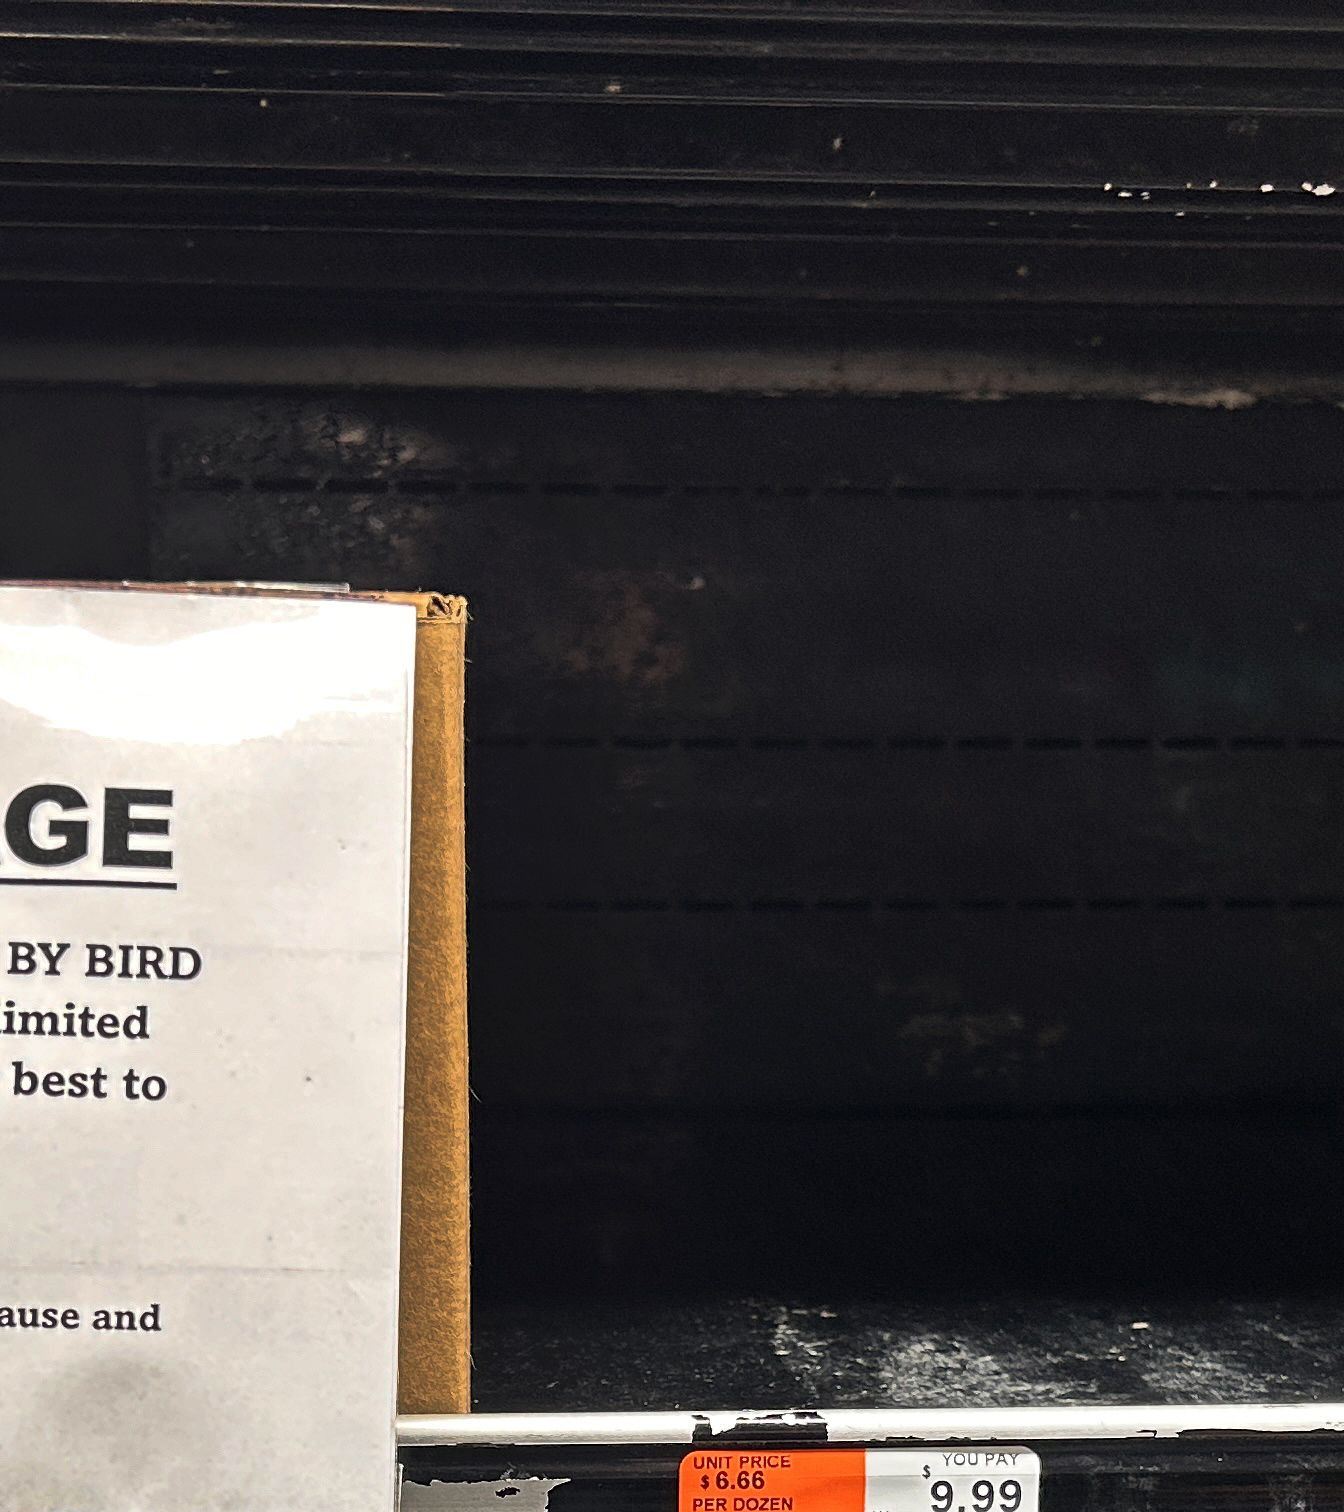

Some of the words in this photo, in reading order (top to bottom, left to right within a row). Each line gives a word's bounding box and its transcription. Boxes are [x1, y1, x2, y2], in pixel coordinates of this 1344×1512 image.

[7, 942, 70, 976] BY
[85, 944, 201, 980] BIRD
[12, 1061, 107, 1098] best
[123, 1069, 167, 1101] to
[92, 1304, 161, 1331] and
[694, 1456, 732, 1470] UNIT
[739, 1455, 791, 1469] PRICE
[942, 1453, 978, 1466] YOU
[985, 1453, 1018, 1466] PAY
[715, 1470, 765, 1490] 6.66
[922, 1464, 931, 1480] $
[692, 1498, 727, 1512] PER
[733, 1497, 793, 1511] DOZEN
